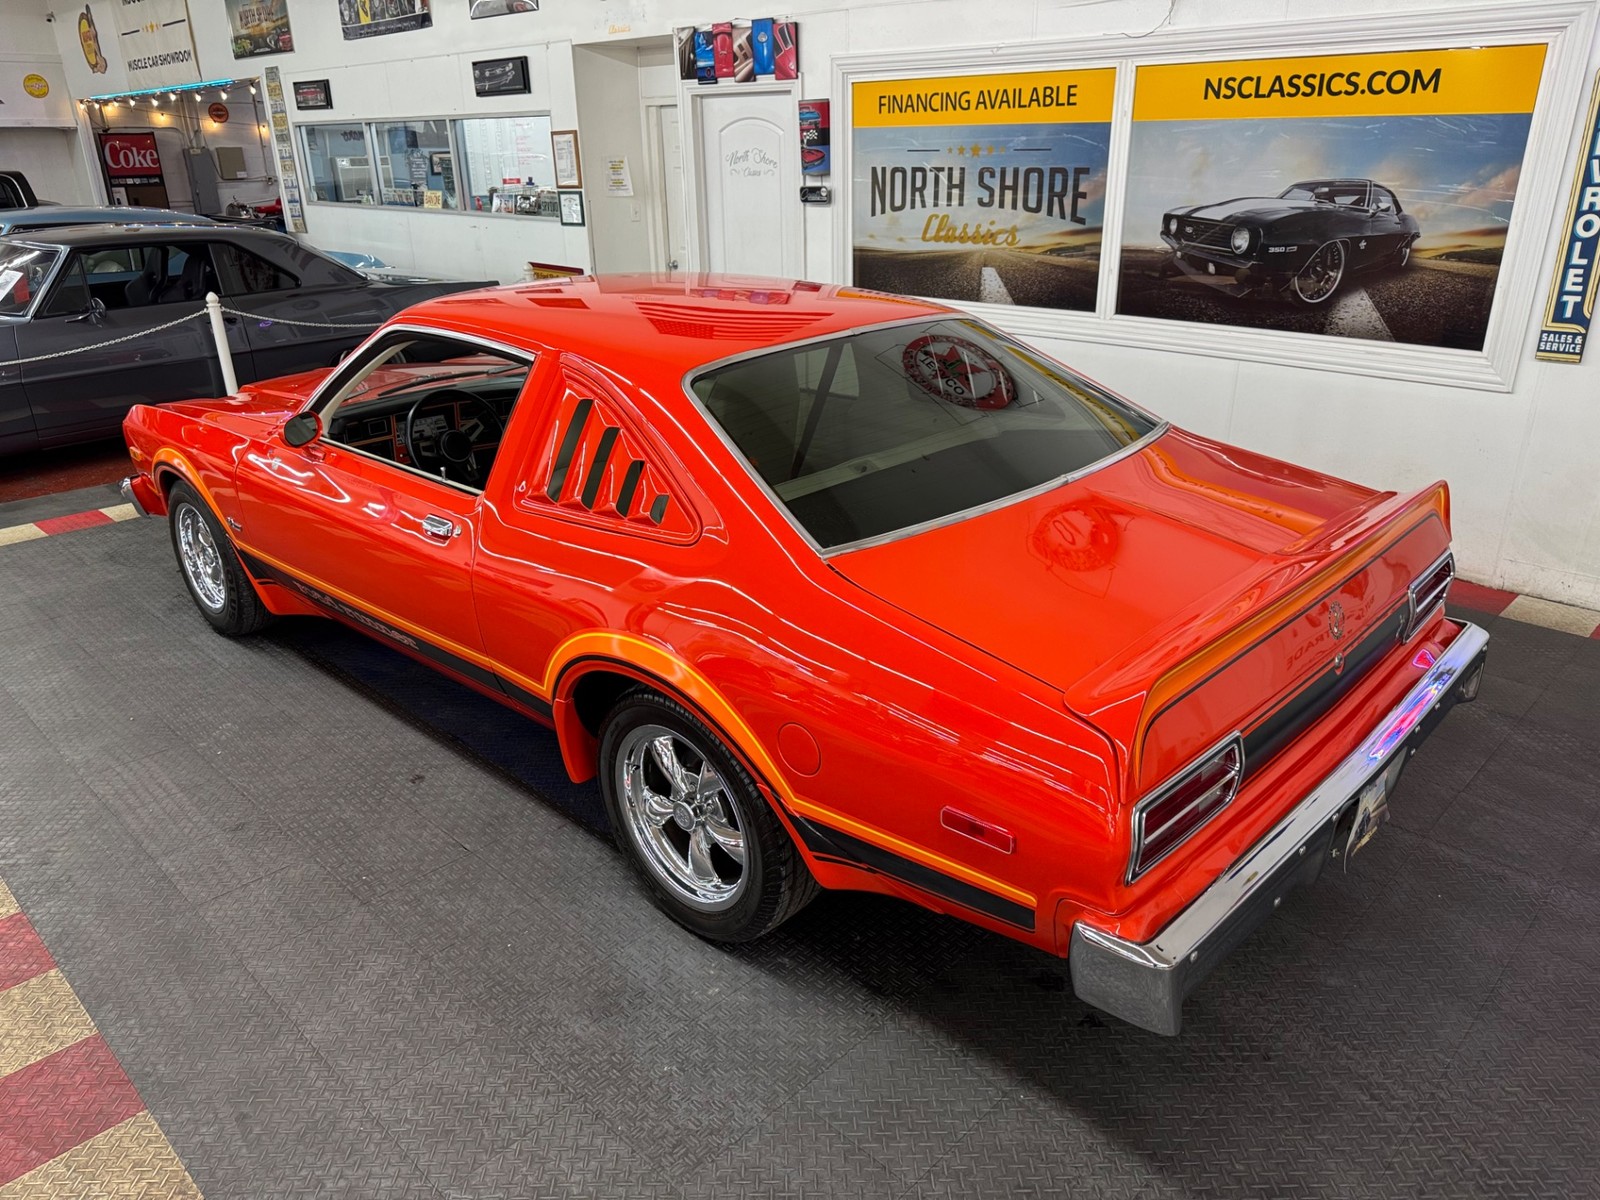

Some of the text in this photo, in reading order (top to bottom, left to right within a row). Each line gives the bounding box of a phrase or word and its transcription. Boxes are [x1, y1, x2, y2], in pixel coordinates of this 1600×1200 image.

[127, 49, 193, 72] MUSCLE CAR SHOWROOM
[878, 84, 1079, 114] FINANCING AVAILABLE
[1203, 67, 1442, 101] NSCLASSICS.COM
[104, 141, 160, 169] Coke
[871, 166, 1091, 226] NORTH SHORE
[921, 213, 1022, 248] Classics
[1560, 131, 1600, 319] ROLET
[1539, 342, 1582, 353] SERVICE
[1541, 333, 1583, 344] SALES &
